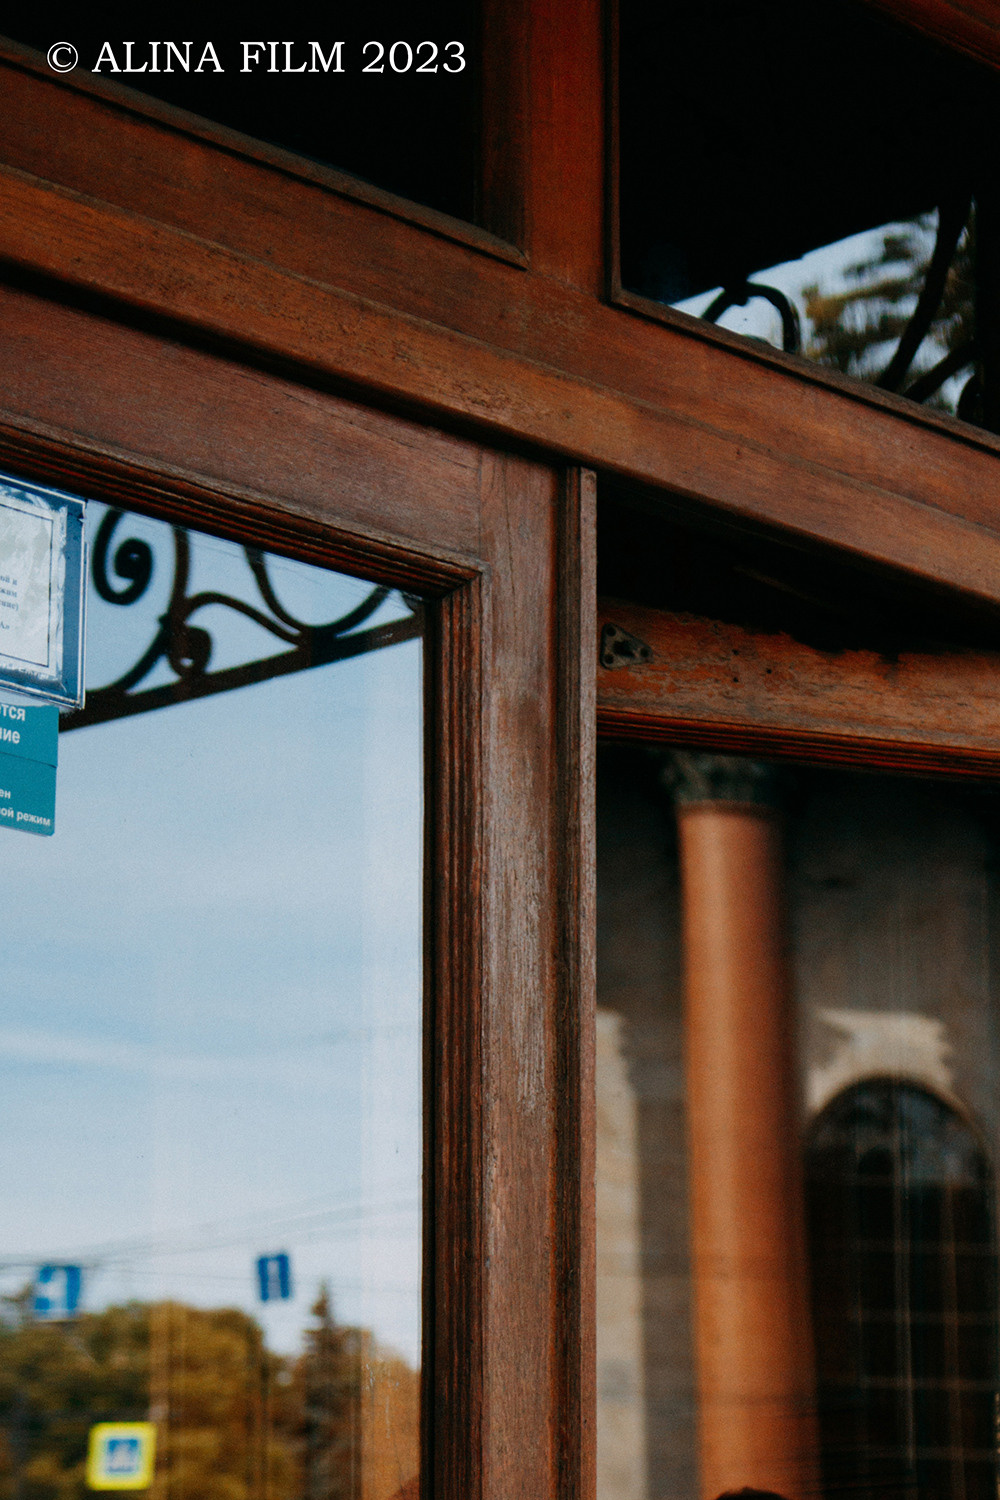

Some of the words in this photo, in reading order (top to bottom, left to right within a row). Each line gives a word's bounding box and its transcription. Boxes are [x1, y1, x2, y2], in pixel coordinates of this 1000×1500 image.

[0, 703, 26, 721] тся
[0, 806, 14, 818] ой
[17, 811, 51, 827] режим
